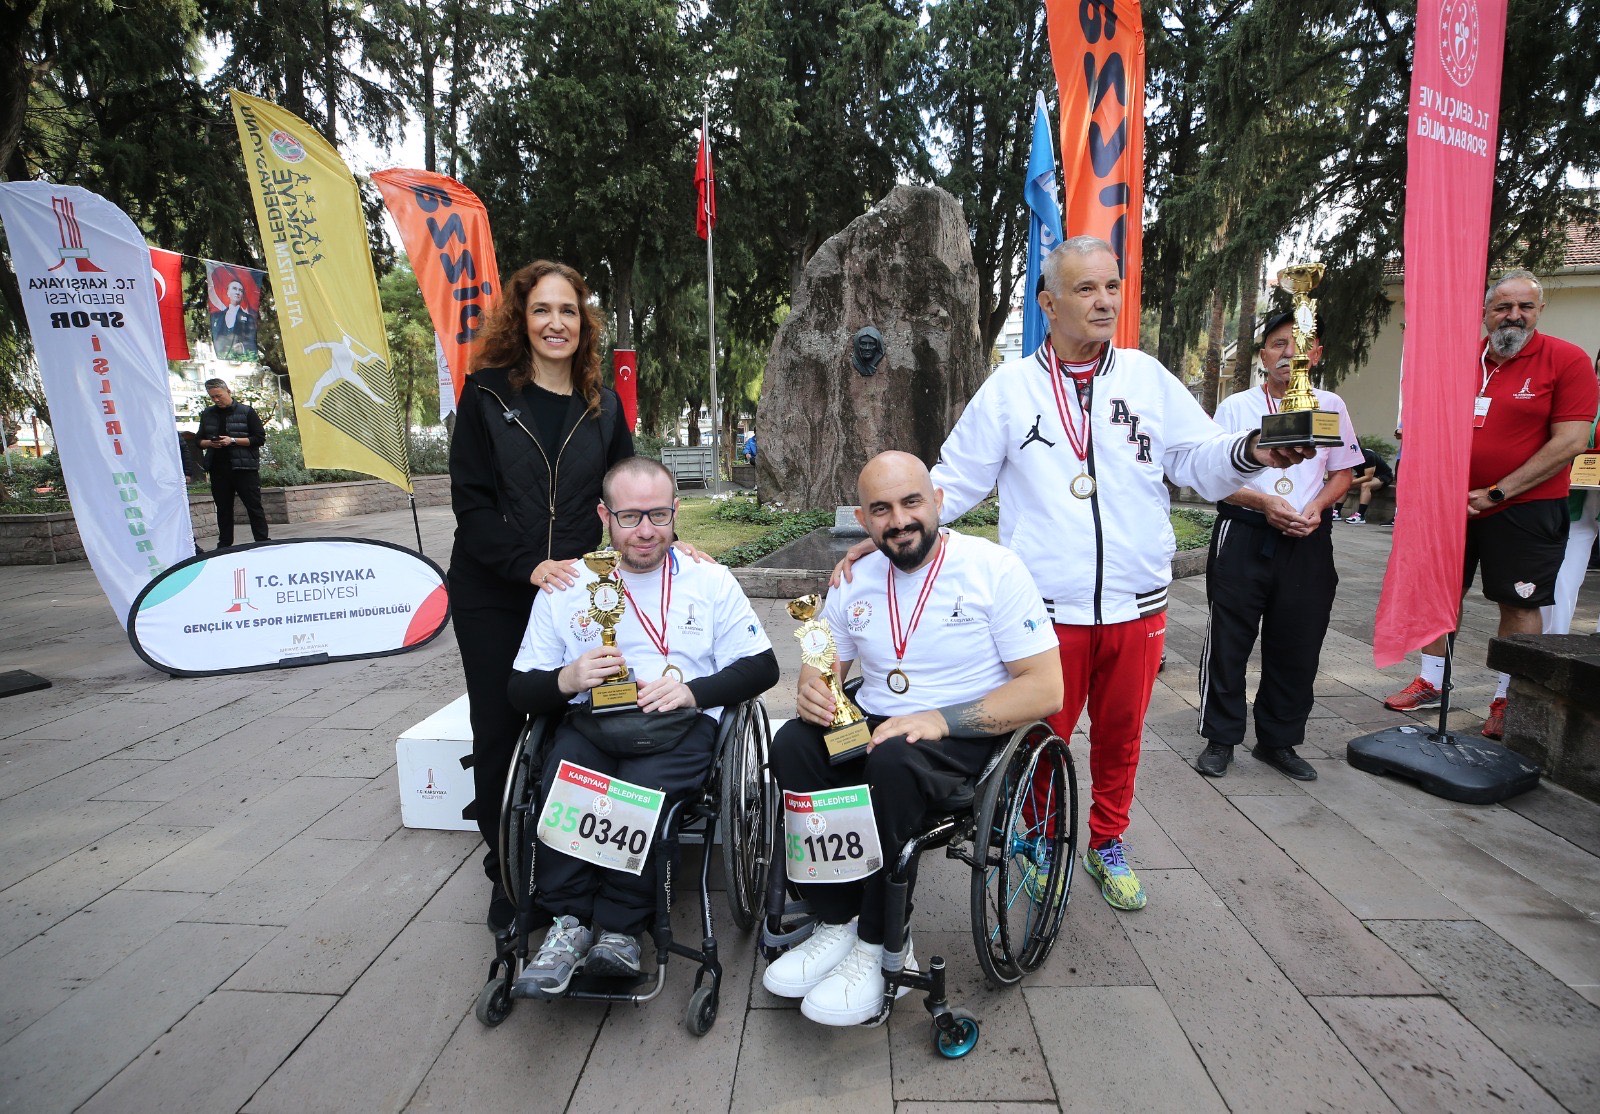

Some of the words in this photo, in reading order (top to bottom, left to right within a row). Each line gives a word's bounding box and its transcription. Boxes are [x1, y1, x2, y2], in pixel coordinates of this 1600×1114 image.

[1110, 398, 1153, 464] AIR
[255, 575, 283, 589] T.C.
[288, 568, 376, 585] KARŞIYAKA
[276, 583, 359, 604] BELEDİYESİ
[183, 620, 233, 634] GENÇLİK
[237, 619, 250, 629] VE
[253, 616, 283, 628] SPOR
[285, 608, 347, 625] HİZMETLERİ
[349, 603, 412, 618] MÜDÜRLÜĞÜ
[568, 770, 608, 791] KARŞIYAKA
[608, 785, 651, 804] BELEDİYESİ
[812, 793, 858, 808] BELEDİYESİ
